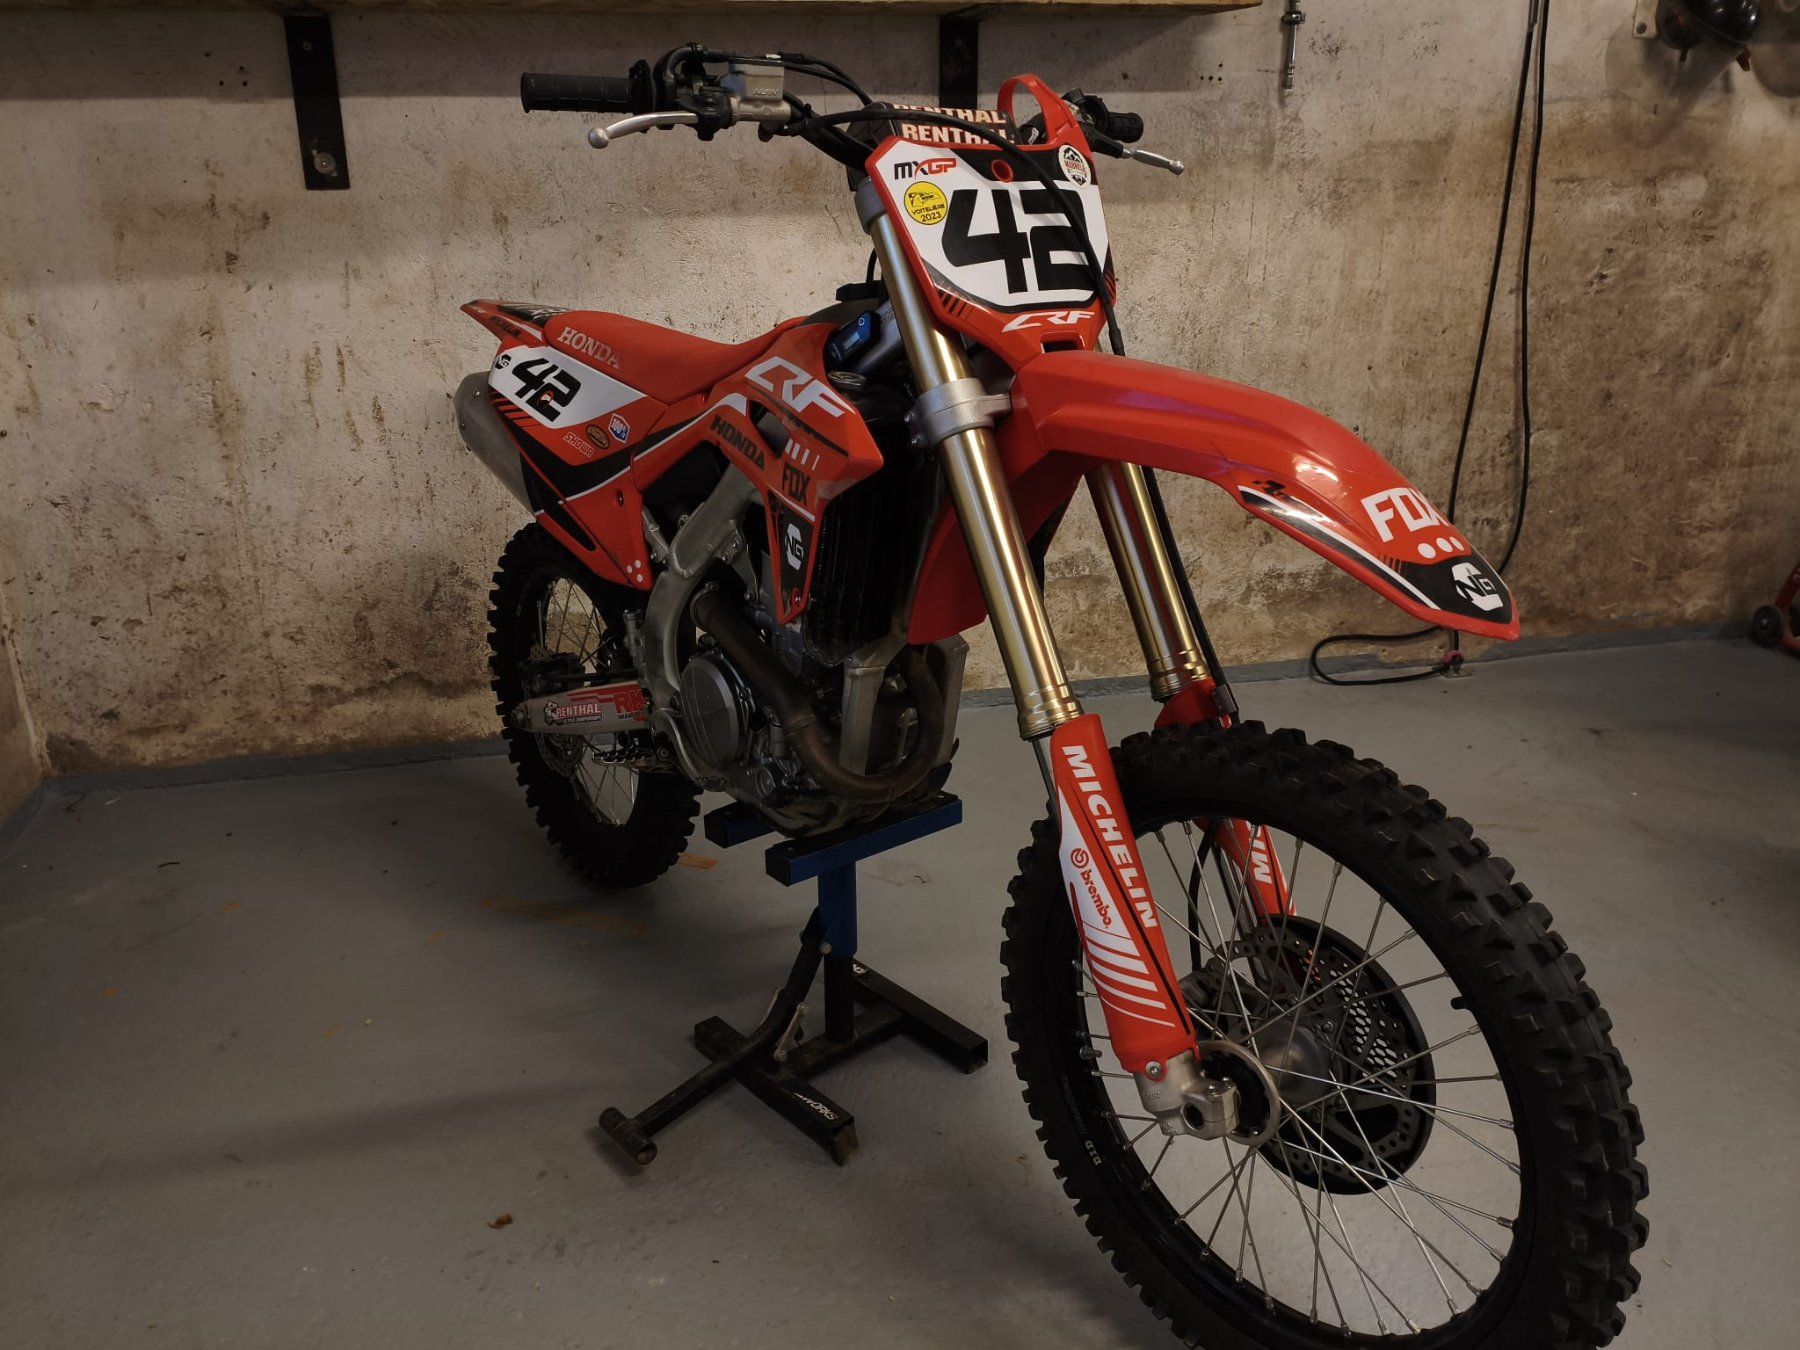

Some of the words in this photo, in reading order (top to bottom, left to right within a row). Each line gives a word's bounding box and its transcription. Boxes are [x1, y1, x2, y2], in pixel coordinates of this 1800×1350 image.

[901, 123, 1015, 145] RENTHL
[894, 158, 957, 180] MXGP
[920, 211, 942, 223] 2023
[941, 188, 1097, 294] 42
[557, 326, 622, 369] HONDA
[512, 358, 582, 422] 42
[744, 356, 857, 418] CRF
[709, 414, 766, 471] HONDA
[782, 462, 811, 507] FOX
[556, 702, 601, 717] RENTHAL
[1062, 745, 1158, 928] MICHELIN
[1080, 870, 1113, 929] brembo
